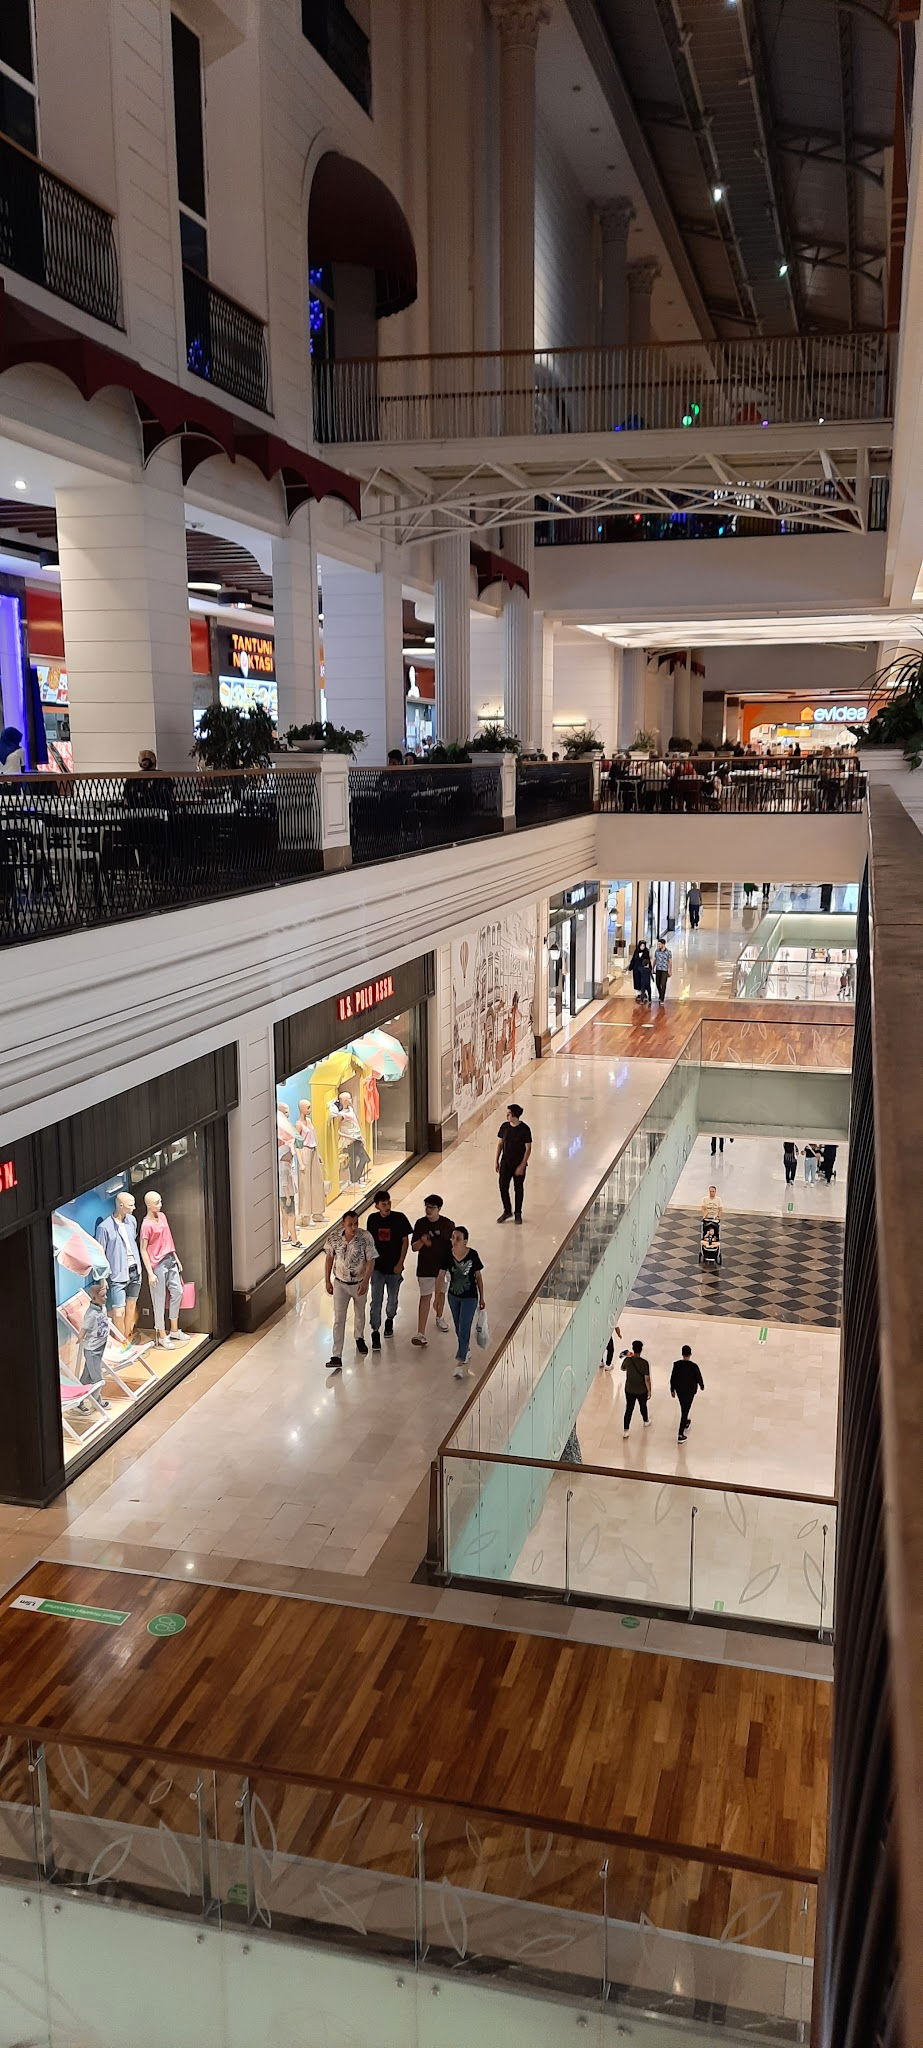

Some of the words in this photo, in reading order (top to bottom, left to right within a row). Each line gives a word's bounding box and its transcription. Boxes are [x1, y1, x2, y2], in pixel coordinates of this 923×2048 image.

[232, 634, 273, 655] TANTUNI
[813, 706, 868, 722] evidea
[339, 995, 353, 1021] U.S.
[355, 985, 373, 1013] POLO
[375, 976, 394, 1003] ASSN.
